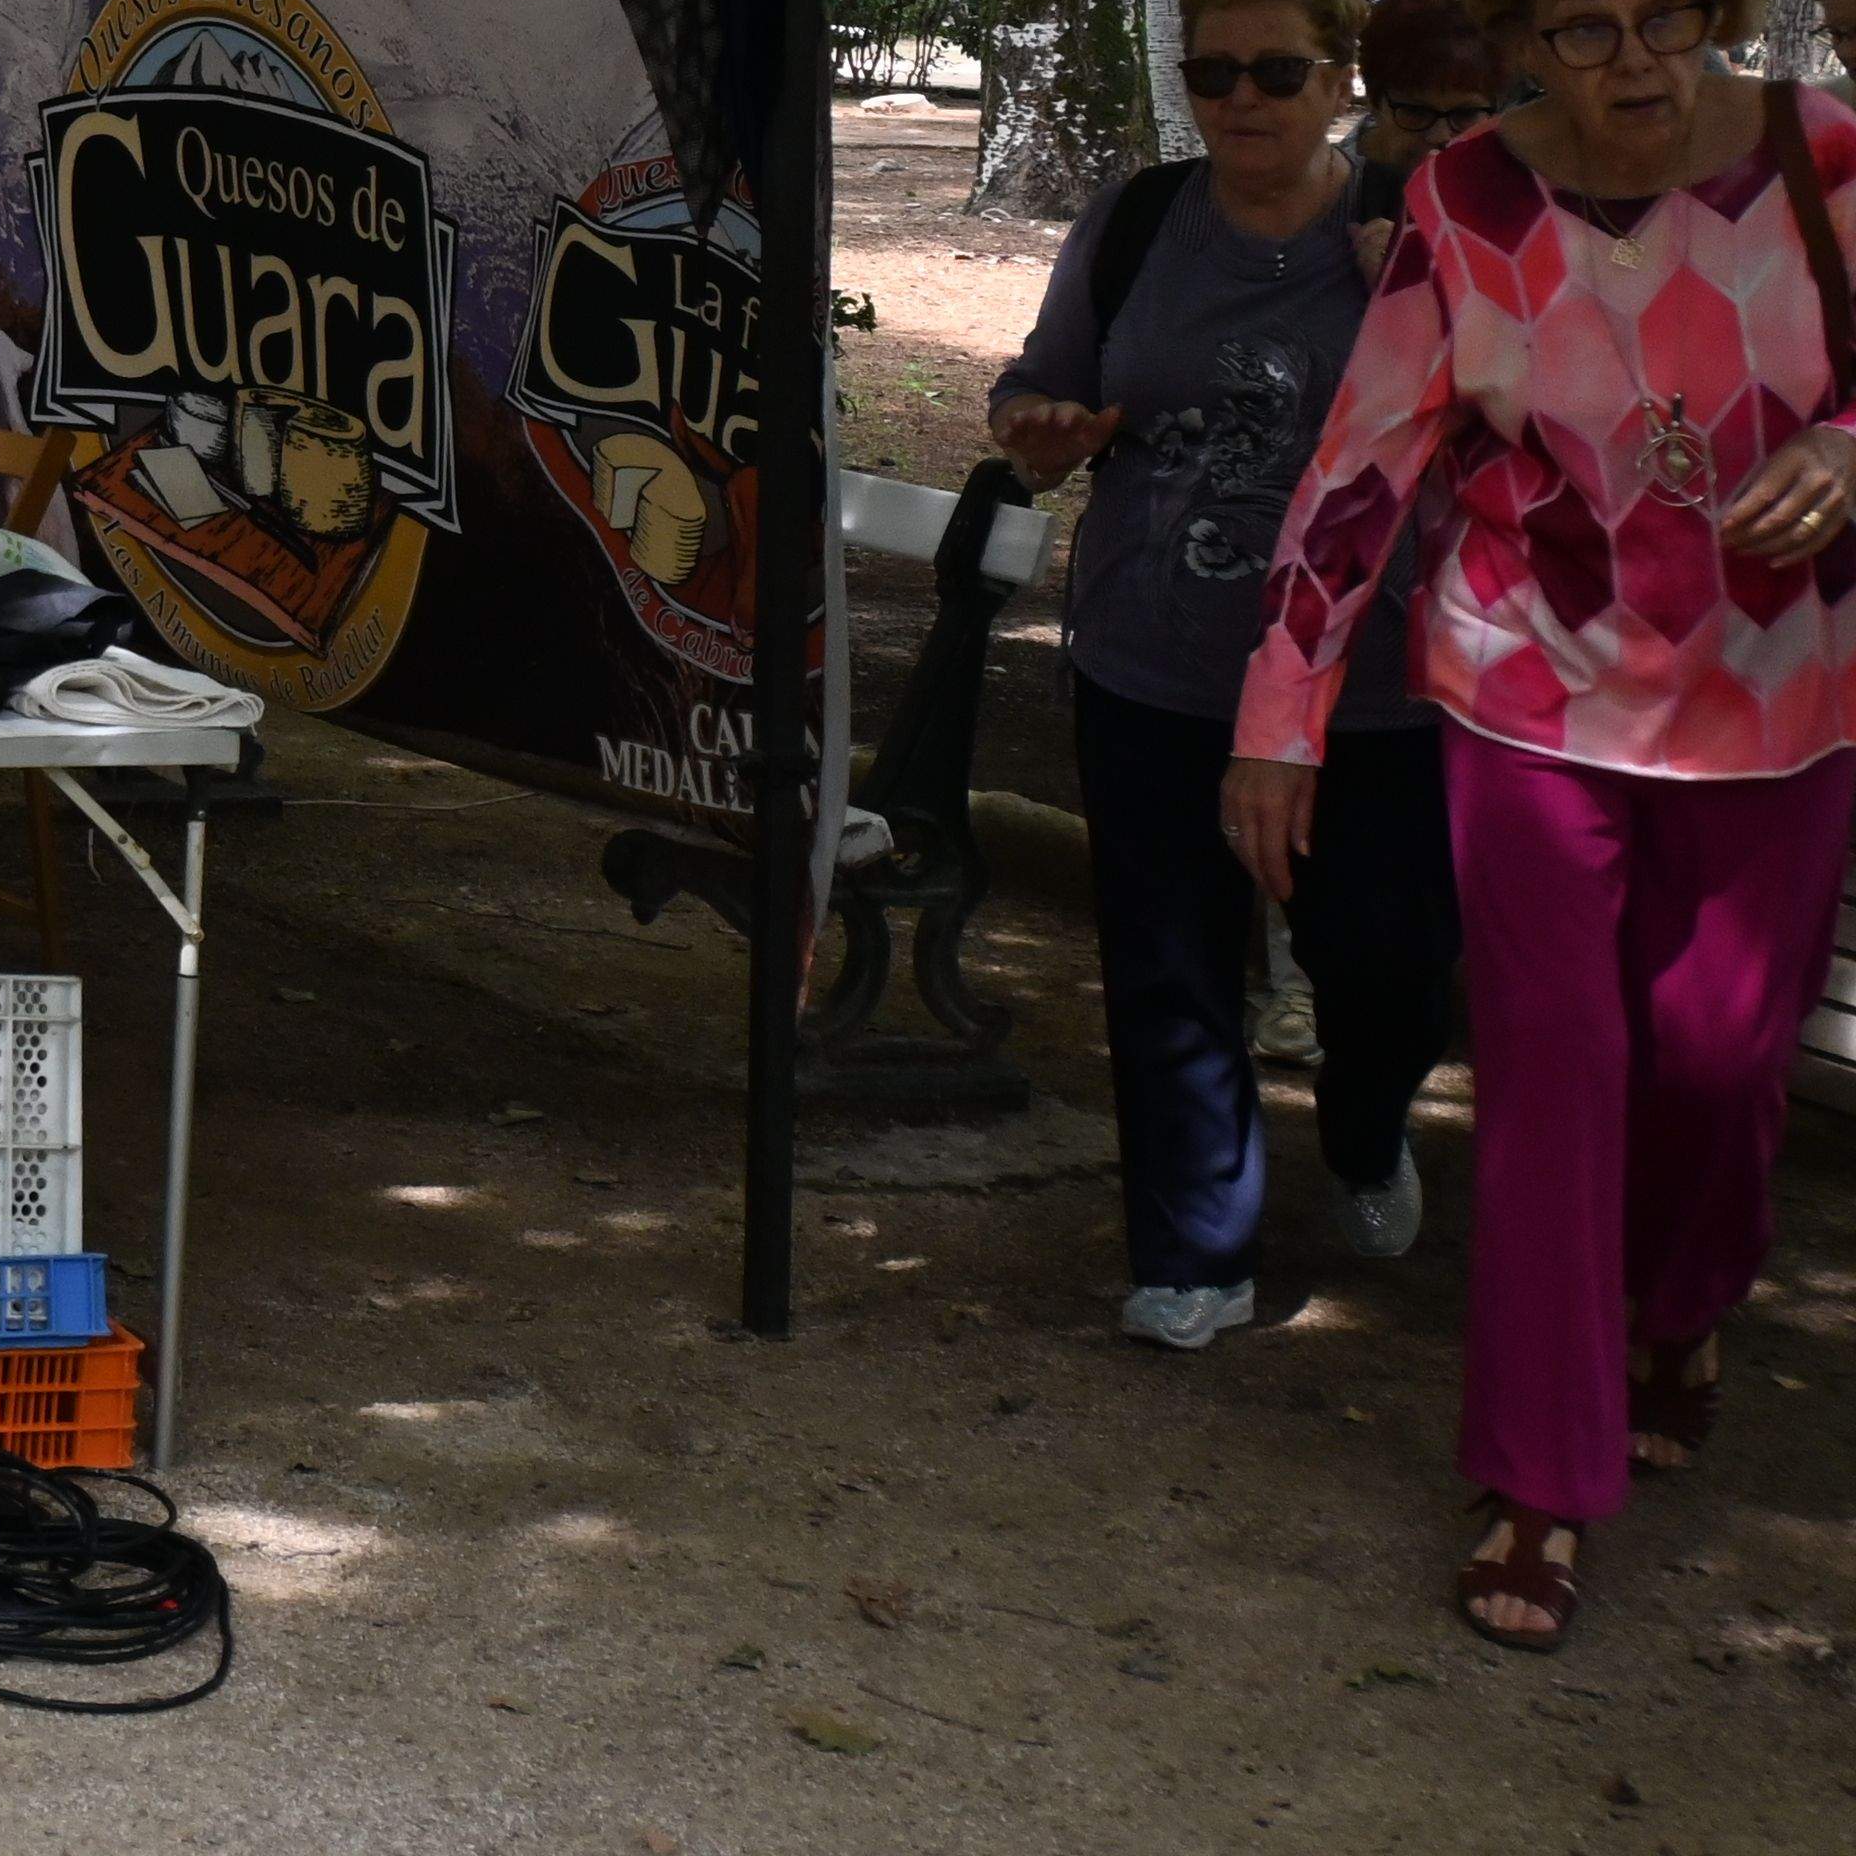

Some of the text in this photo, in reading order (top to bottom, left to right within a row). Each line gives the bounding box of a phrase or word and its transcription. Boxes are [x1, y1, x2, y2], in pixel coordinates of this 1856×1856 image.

[176, 126, 407, 252] Quesos de
[57, 111, 425, 459] Guara
[673, 252, 723, 331] La
[622, 567, 651, 611] de
[269, 668, 294, 696] de
[297, 609, 388, 701] Rodellar
